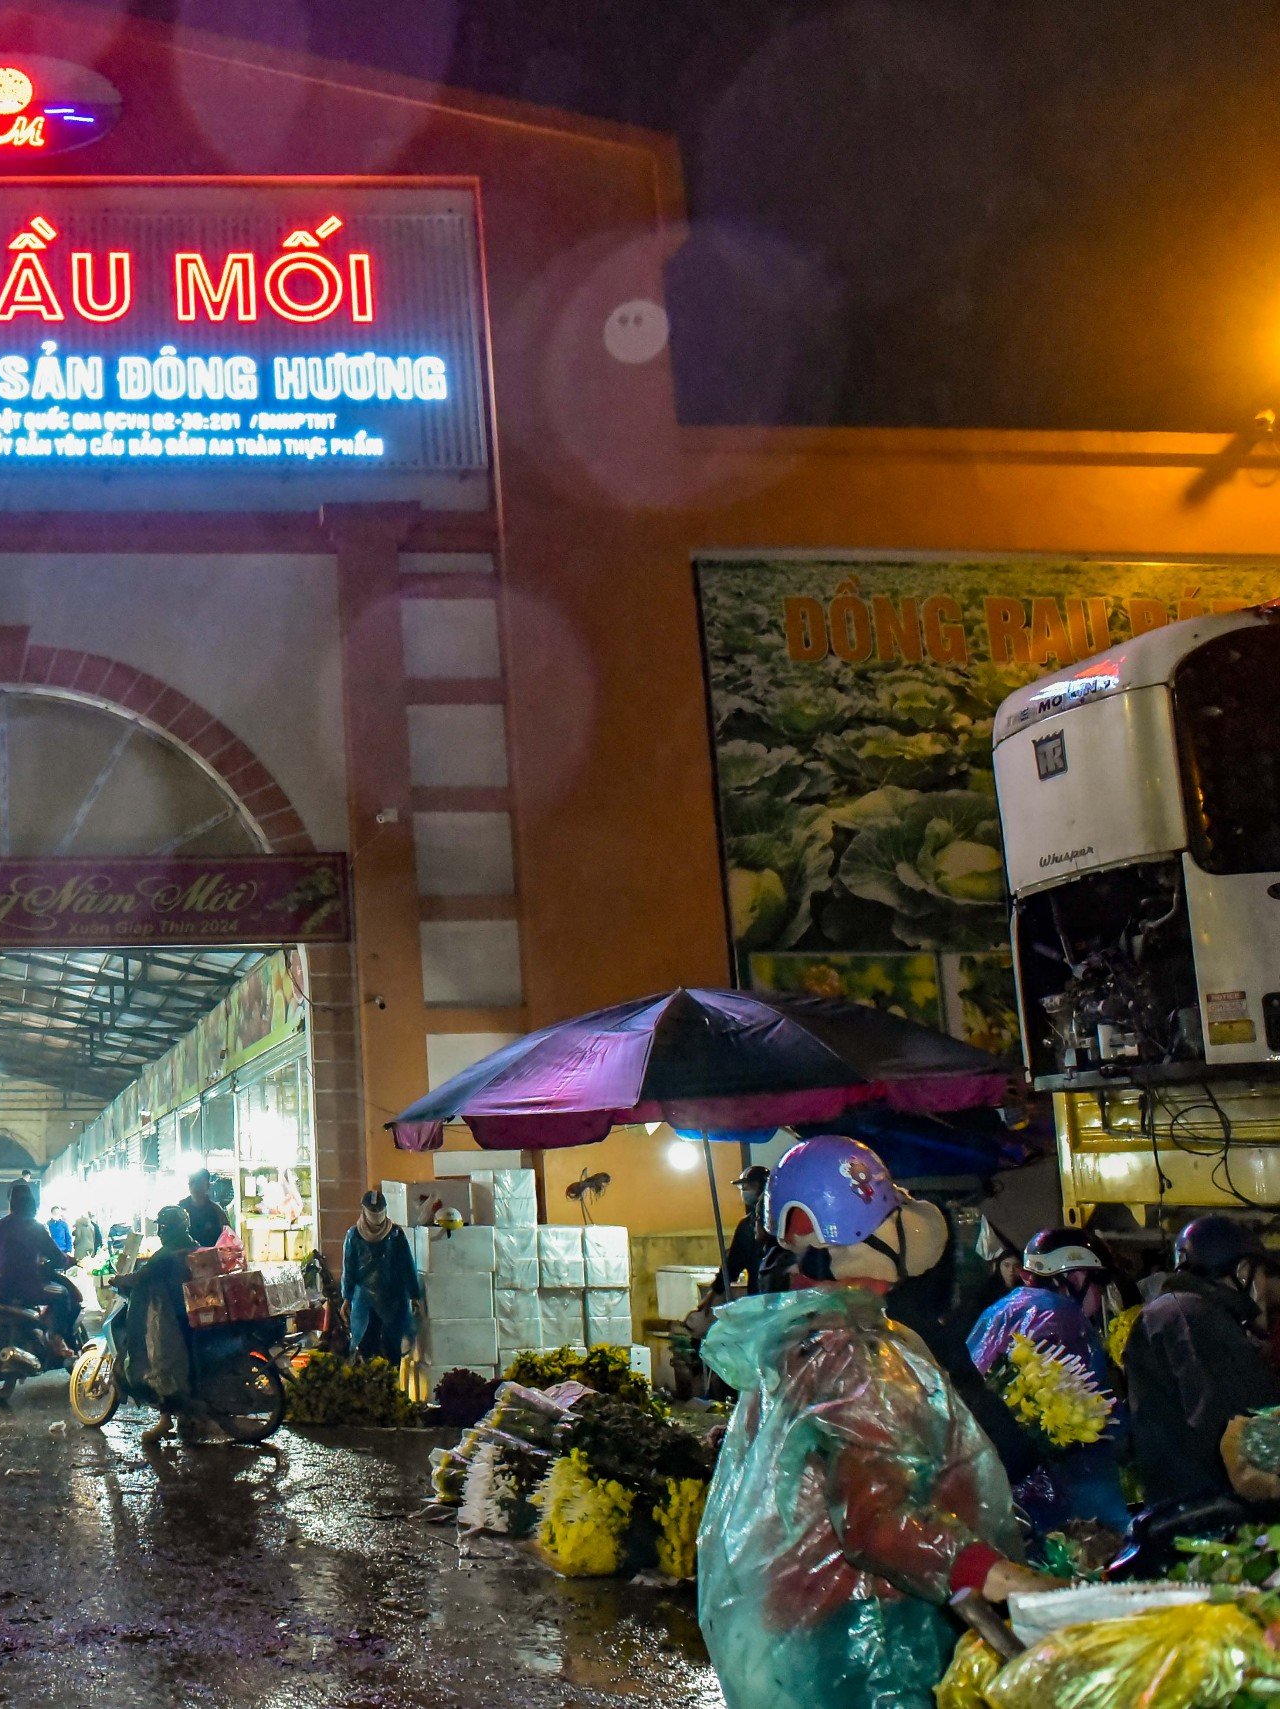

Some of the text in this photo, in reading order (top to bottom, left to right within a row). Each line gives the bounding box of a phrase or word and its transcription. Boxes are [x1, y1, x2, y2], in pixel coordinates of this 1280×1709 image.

[174, 214, 376, 323] MỐI
[117, 345, 258, 400] ĐÔNG
[274, 351, 448, 401] HƯƠNG
[209, 438, 233, 455] AN
[783, 573, 969, 665] ĐỒNG
[984, 596, 1112, 665] RAU
[1038, 845, 1094, 869] Whisper
[10, 874, 143, 914] Năm
[135, 872, 258, 914] Mới
[201, 918, 239, 933] 2024
